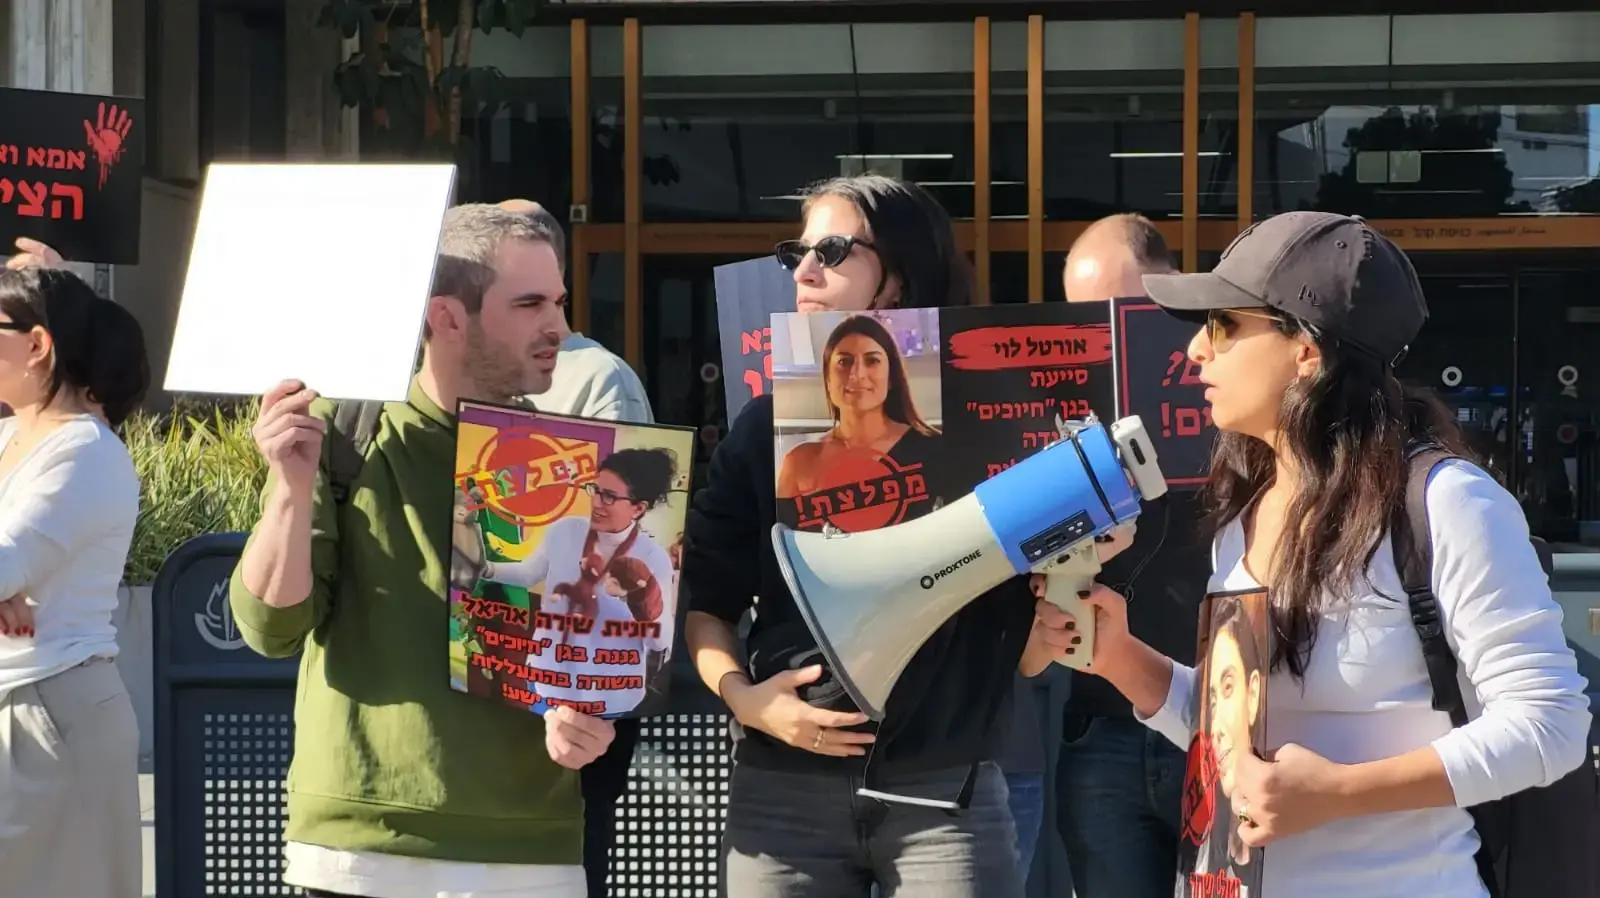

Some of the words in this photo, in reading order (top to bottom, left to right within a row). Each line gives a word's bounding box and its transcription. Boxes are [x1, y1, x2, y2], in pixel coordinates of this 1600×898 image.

[27, 147, 86, 170] אמא
[0, 177, 84, 220] הצי
[994, 338, 1022, 358] לוי
[1026, 337, 1087, 356] אורטל
[1030, 368, 1089, 388] סייעת
[1060, 399, 1090, 419] בגן
[1161, 402, 1212, 438] ים!
[1022, 431, 1061, 449] ודה
[793, 473, 927, 522] מפלצת!
[934, 549, 982, 580] PROXTONE
[459, 590, 529, 625] אריאל
[535, 610, 594, 635] שירה
[601, 619, 662, 639] רונית
[555, 644, 587, 663] בגן
[593, 648, 640, 665] גננת
[471, 652, 572, 688] בהתעללות
[576, 674, 643, 690] חשודה
[502, 683, 541, 707] ישע!
